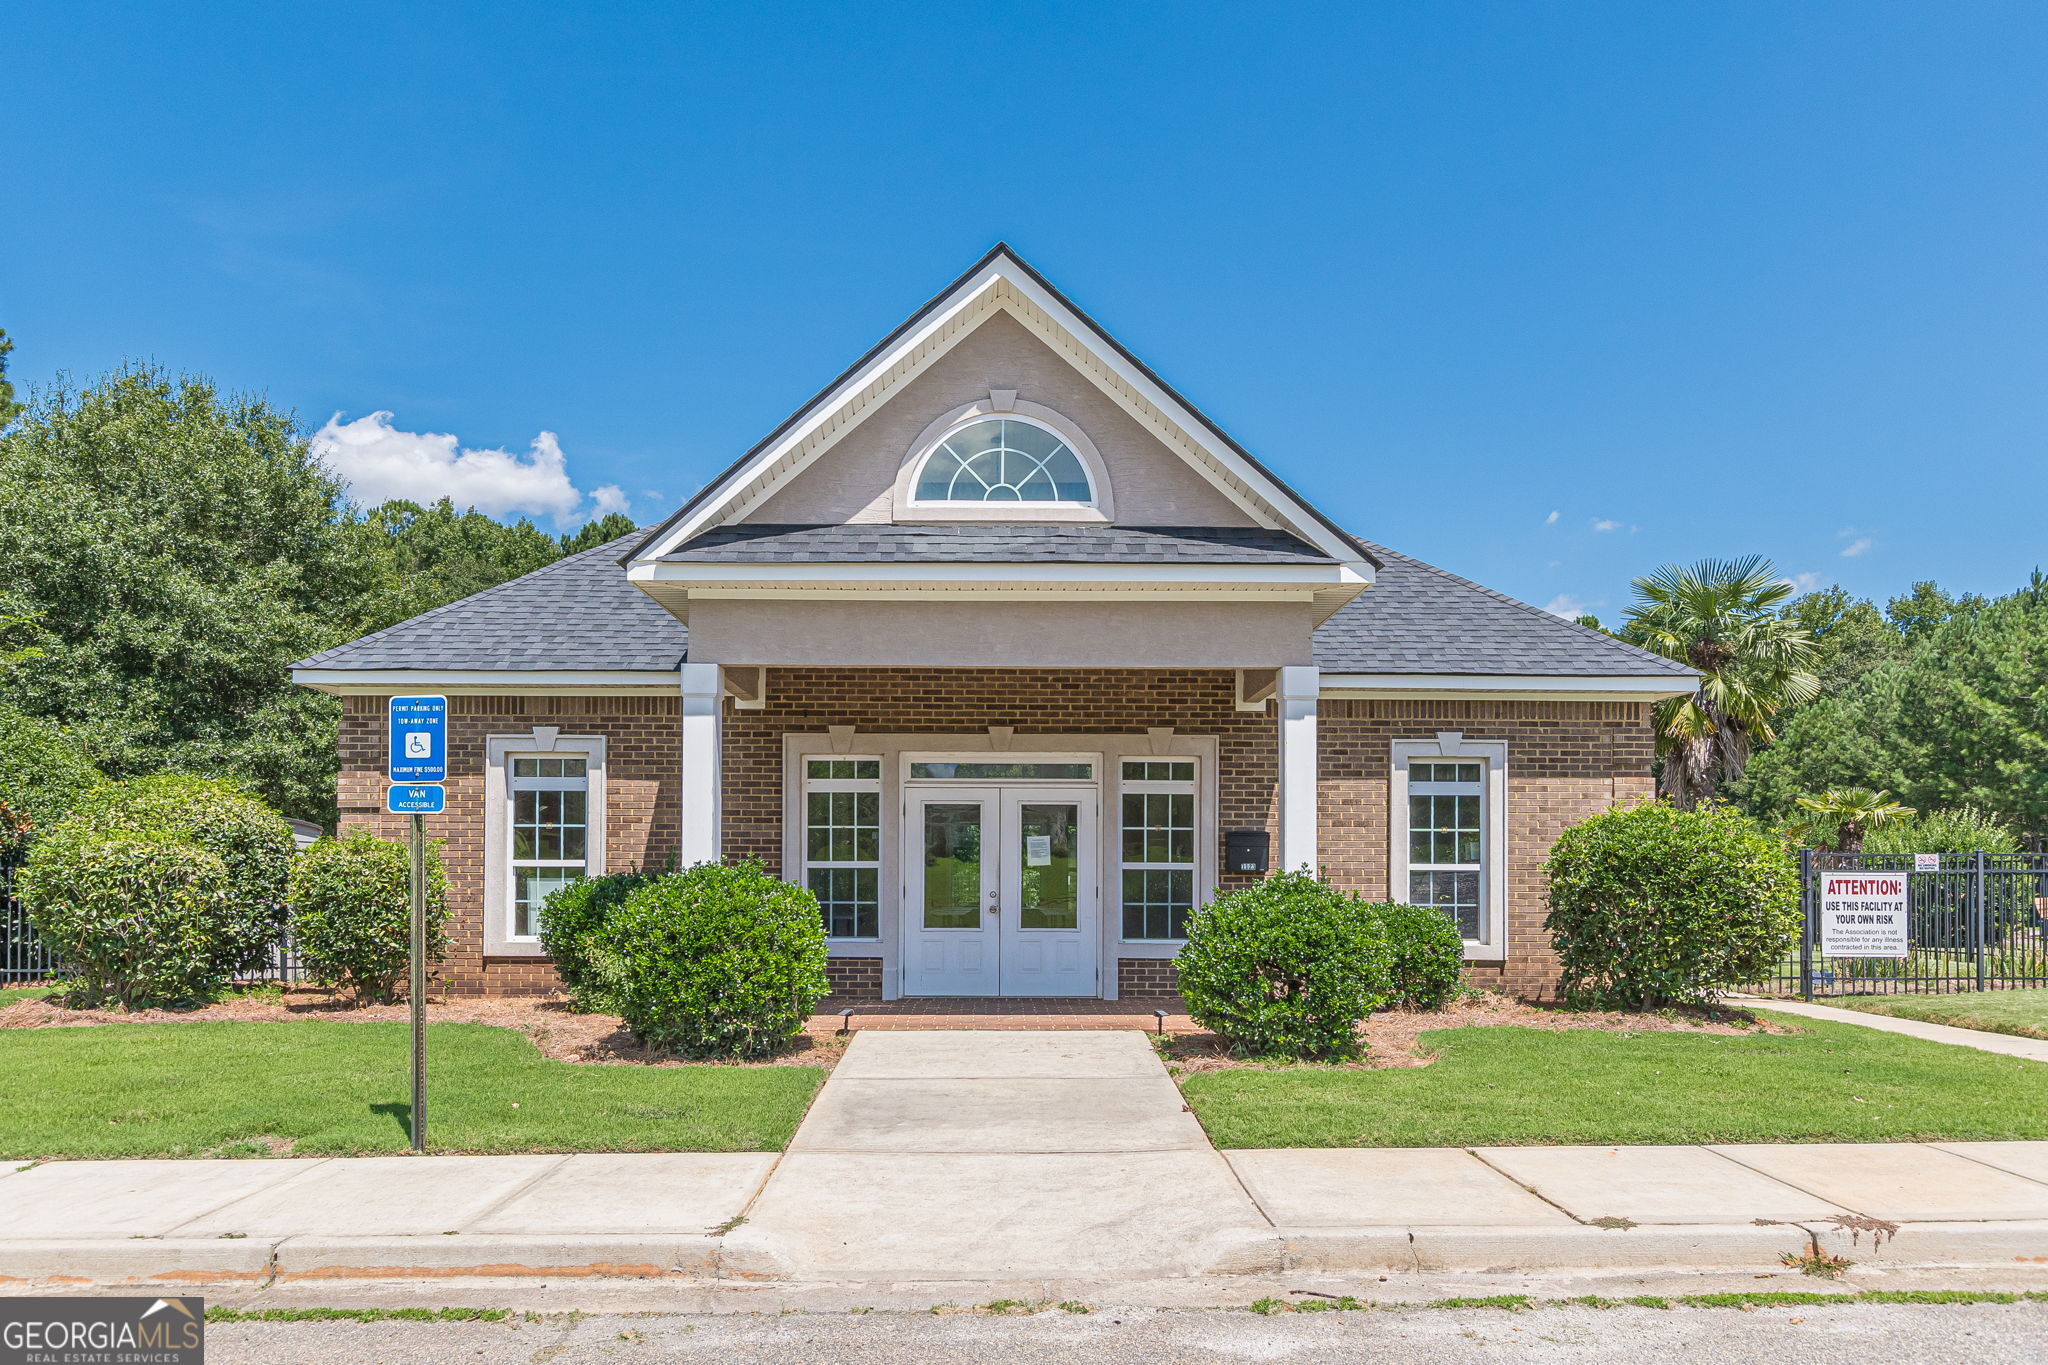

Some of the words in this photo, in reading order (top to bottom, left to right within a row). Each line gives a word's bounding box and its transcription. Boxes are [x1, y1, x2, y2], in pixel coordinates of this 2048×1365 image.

[426, 717, 439, 725] ZONE
[408, 789, 426, 799] VAN
[1827, 879, 1902, 896] ATTENTION:
[1825, 901, 1840, 912] USE
[1841, 901, 1859, 912] THIS
[1860, 901, 1893, 912] FACILITY
[1893, 901, 1904, 912] AT
[1835, 914, 1856, 925] YOUR
[1857, 914, 1875, 925] OWN
[1876, 914, 1894, 925] RISK
[1825, 936, 1861, 944] responsible
